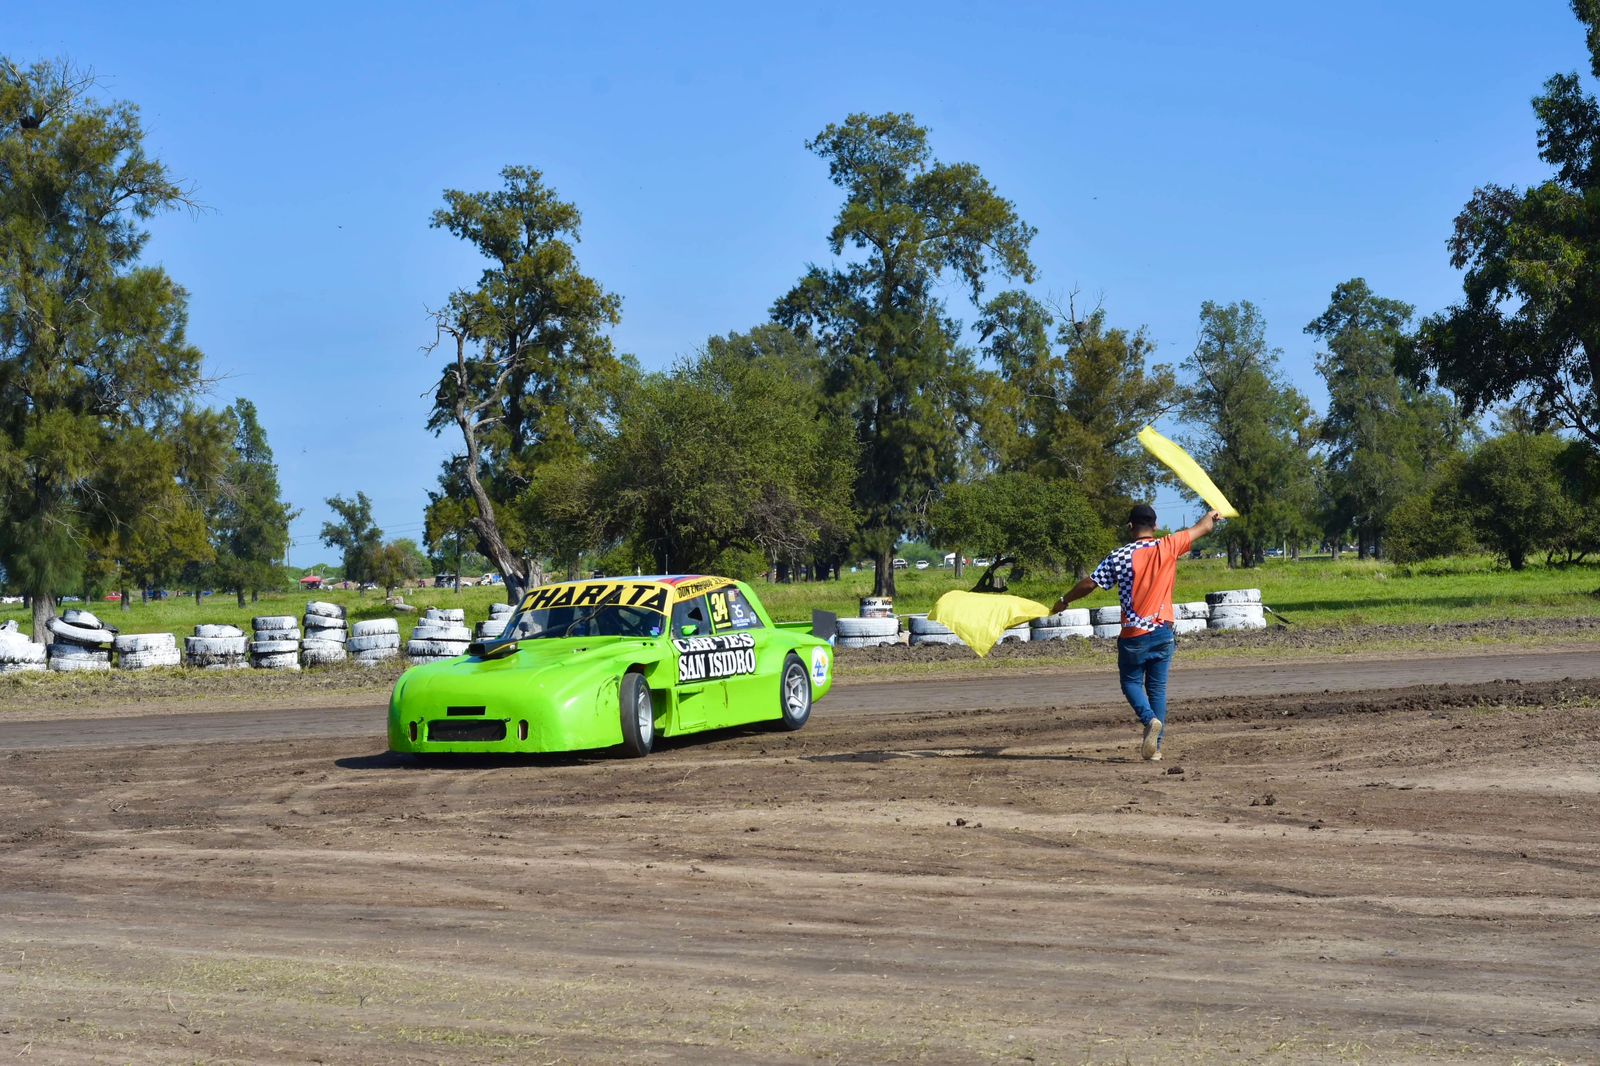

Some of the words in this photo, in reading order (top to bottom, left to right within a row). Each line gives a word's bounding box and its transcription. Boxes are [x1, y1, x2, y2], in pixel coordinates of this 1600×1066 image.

[520, 584, 668, 613] CHARATA
[711, 592, 729, 622] 34
[678, 654, 706, 681] SAN
[708, 648, 756, 677] ISIDRO
